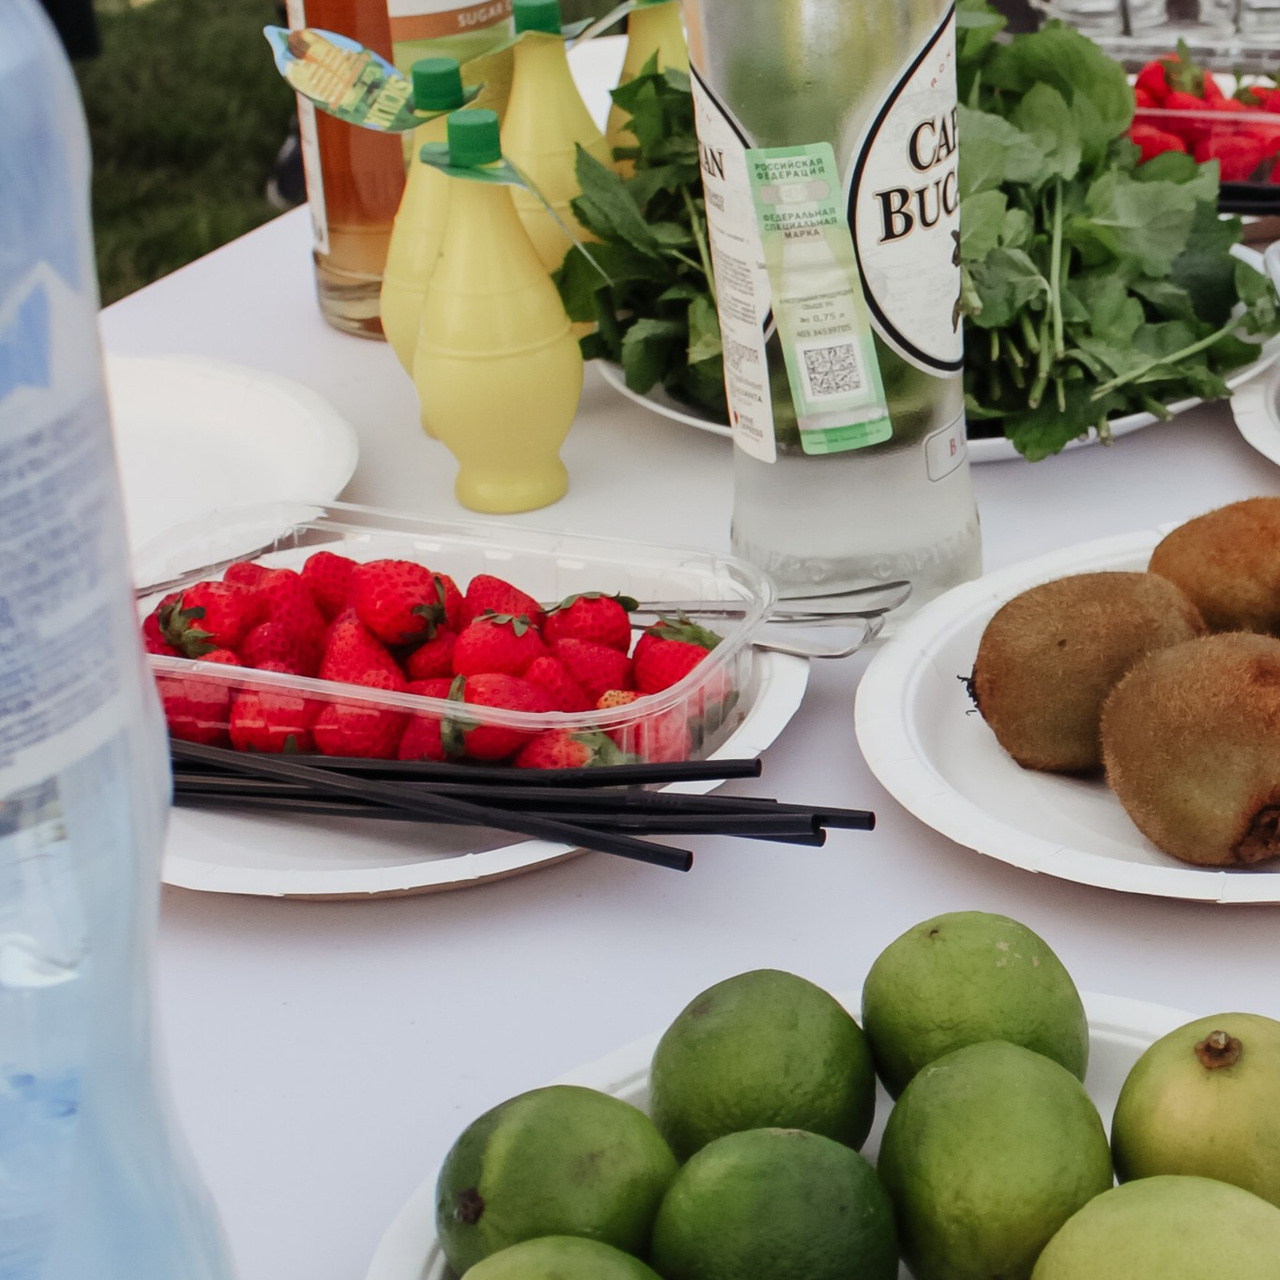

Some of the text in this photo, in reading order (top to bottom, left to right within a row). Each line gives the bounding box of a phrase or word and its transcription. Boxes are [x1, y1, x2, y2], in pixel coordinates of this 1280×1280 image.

[457, 2, 503, 28] SUGAR
[754, 157, 823, 172] РОССИЙСКАЯ
[756, 166, 825, 180] ФЕДЕРАЦИЯ
[763, 206, 836, 222] ФЕДЕРАЛЬНАЯ
[763, 217, 837, 231] СПЕЦИАЛЬНАЯ
[784, 228, 820, 239] МАРКА
